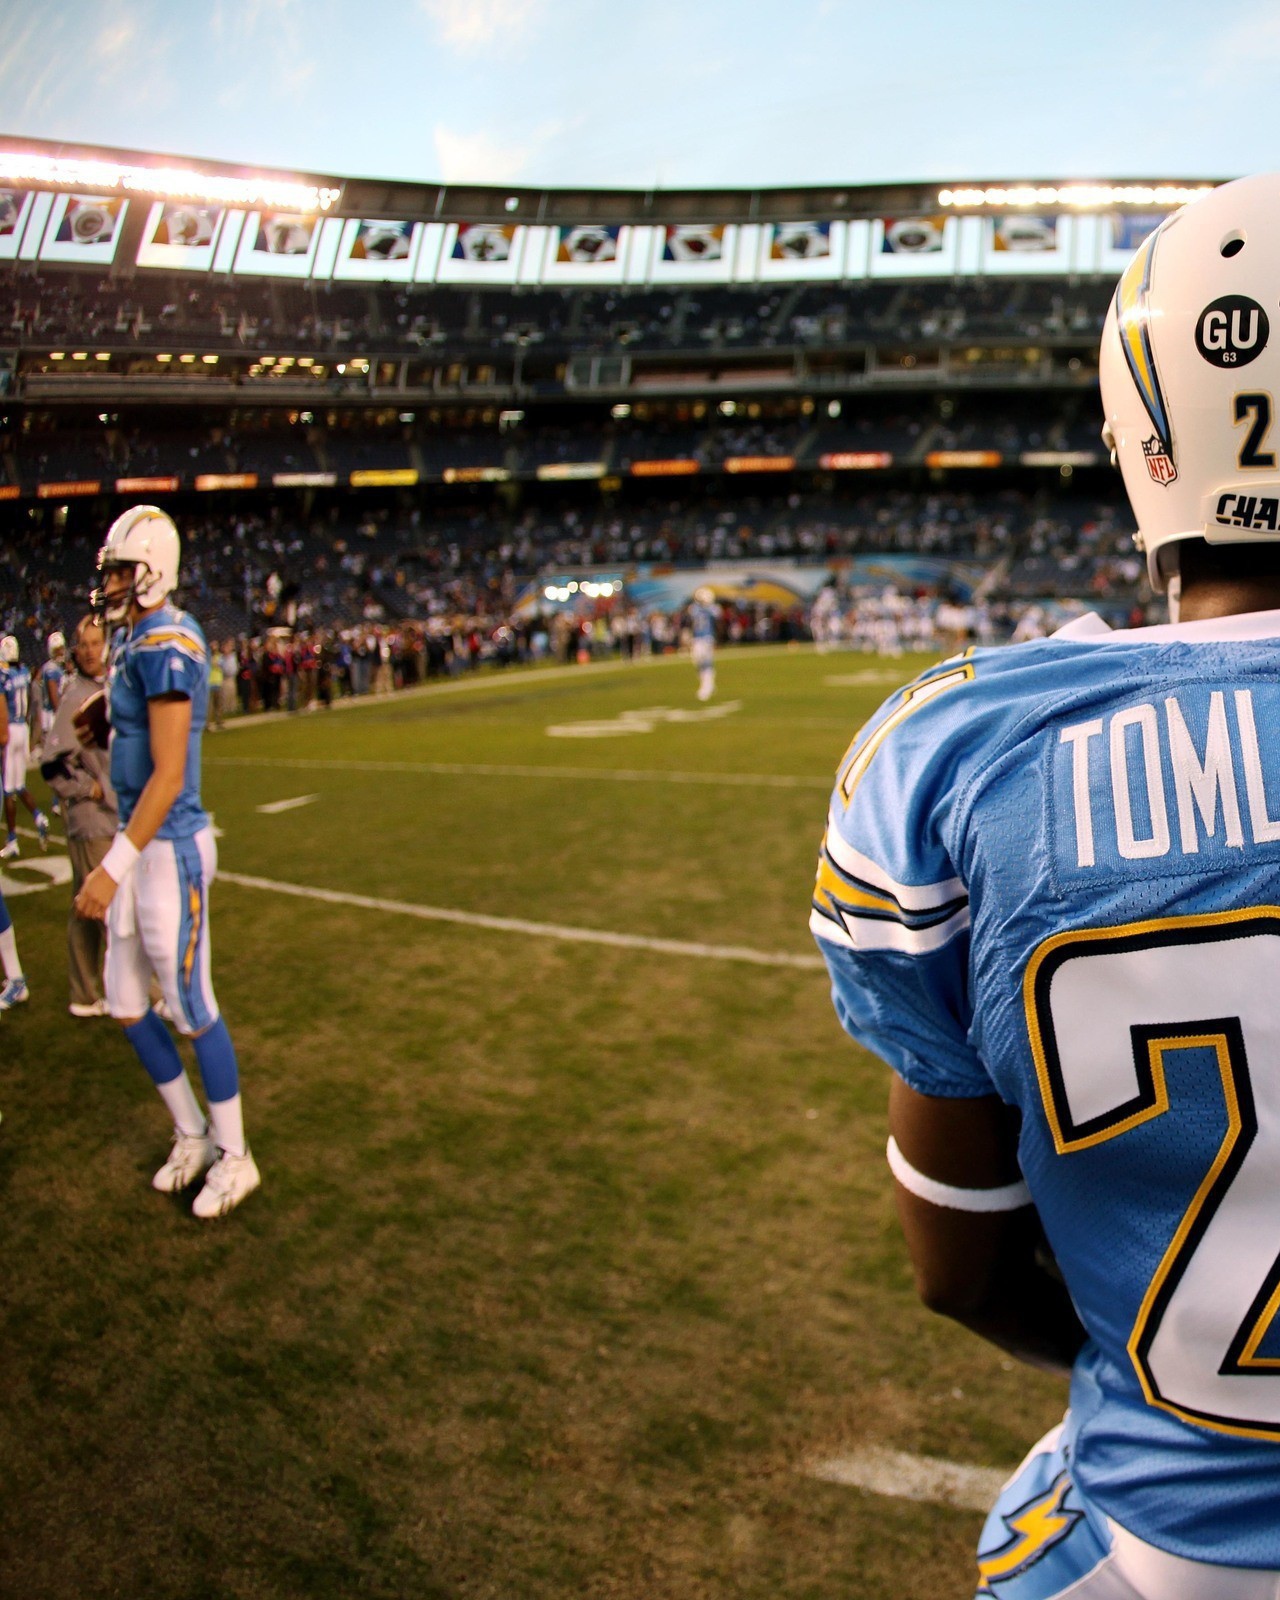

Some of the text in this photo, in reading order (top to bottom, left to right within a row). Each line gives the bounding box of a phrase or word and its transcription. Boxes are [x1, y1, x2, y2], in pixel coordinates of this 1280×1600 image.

[1202, 309, 1259, 350] GU
[1222, 352, 1237, 363] 63
[1147, 457, 1175, 481] NFL
